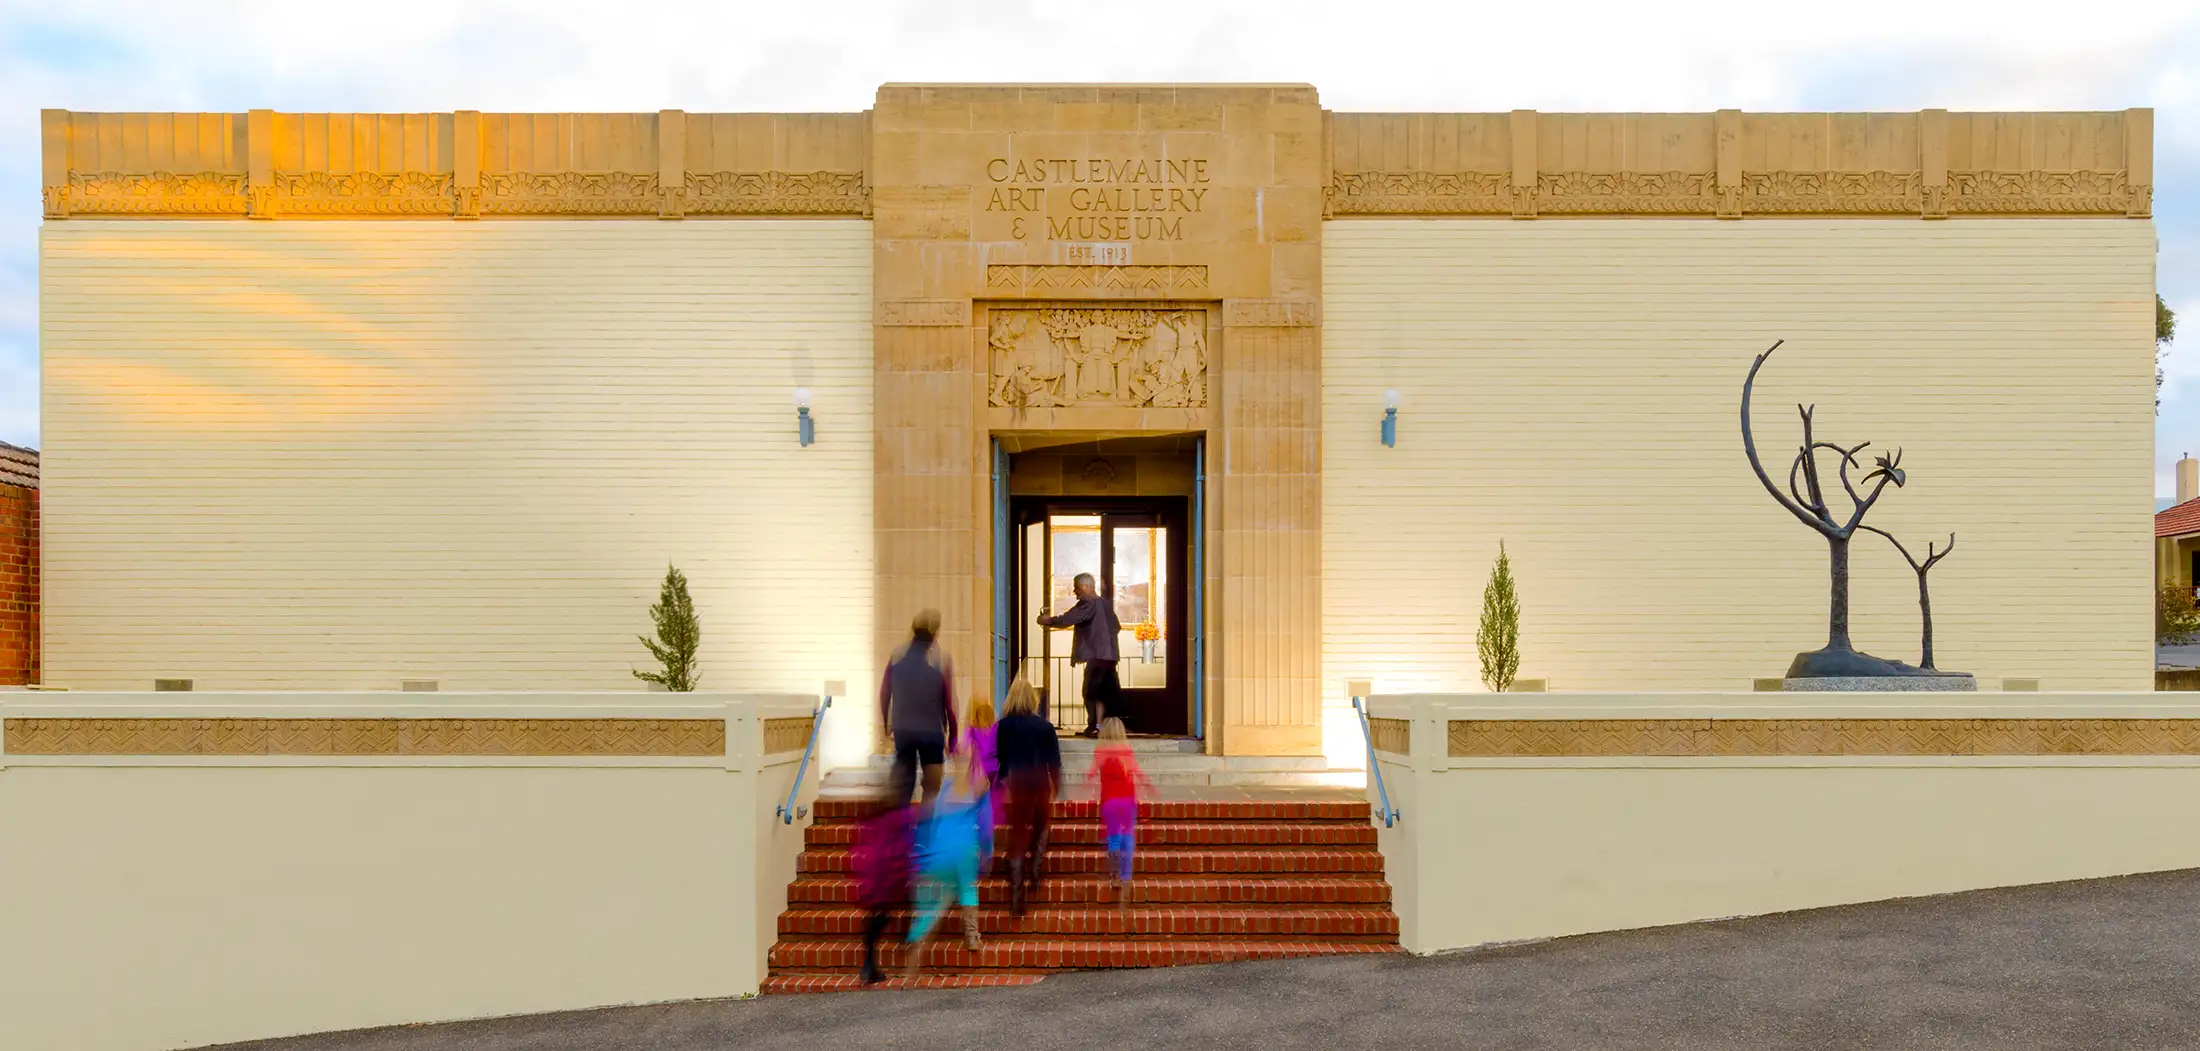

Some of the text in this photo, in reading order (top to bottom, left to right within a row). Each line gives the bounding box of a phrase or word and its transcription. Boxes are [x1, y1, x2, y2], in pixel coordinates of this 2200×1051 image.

[986, 158, 1210, 183] CASTLEMAINE
[985, 187, 1208, 212] ART GALLERY
[1046, 216, 1183, 240] MUSEUM
[1069, 246, 1127, 260] EST. 1913
